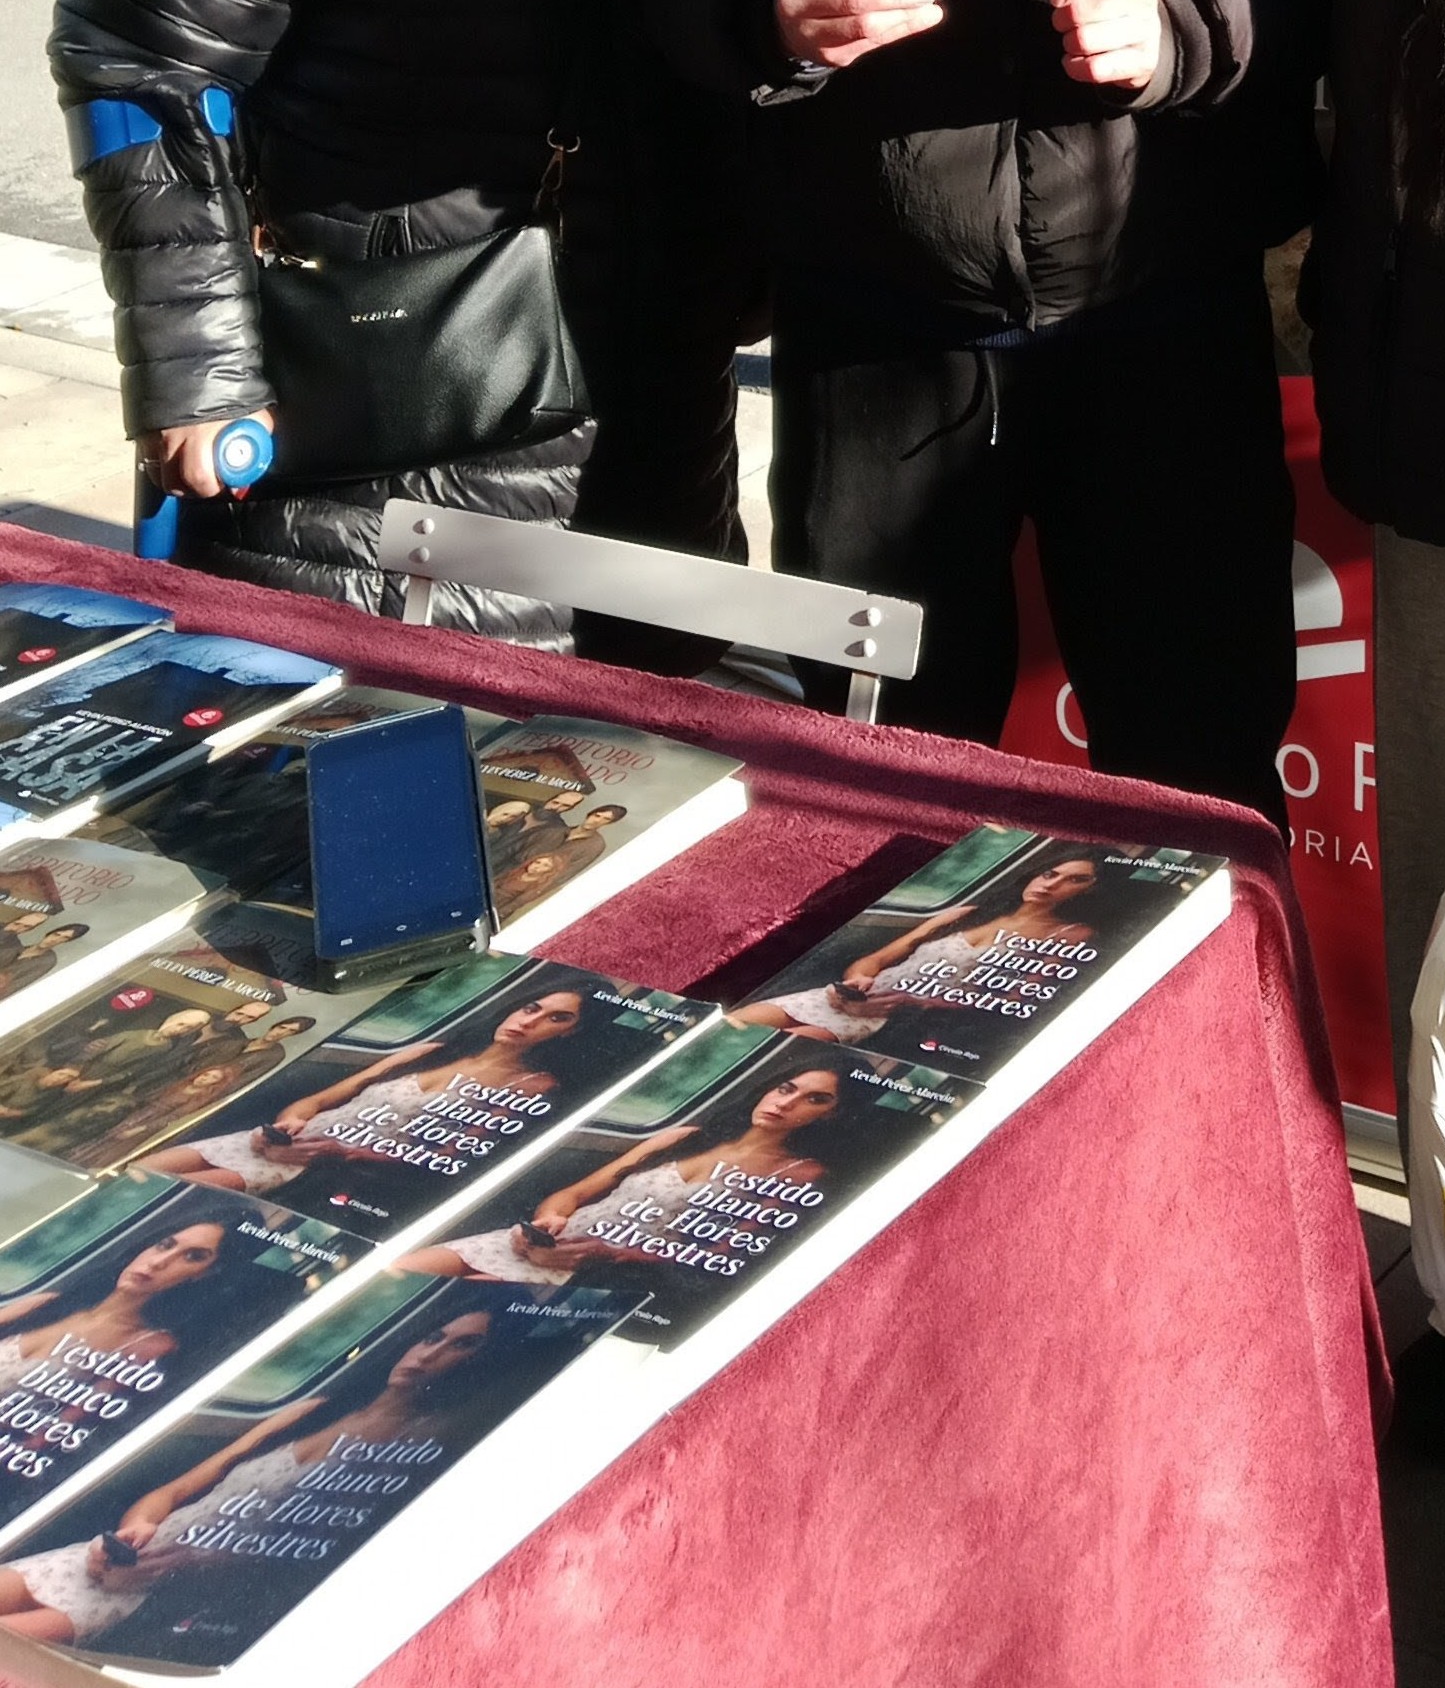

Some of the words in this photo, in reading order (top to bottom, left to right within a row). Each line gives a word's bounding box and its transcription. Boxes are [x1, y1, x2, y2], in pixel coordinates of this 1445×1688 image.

[515, 730, 656, 771] TERRITORIO
[977, 946, 1079, 984] blanco
[991, 928, 1099, 965] Vestido
[892, 973, 1037, 1021] silvestres
[918, 957, 958, 980] de
[962, 965, 1059, 1003] flores
[421, 1090, 525, 1137] blanco
[446, 1072, 553, 1118] Vestido
[323, 1119, 469, 1177] silvestres
[357, 1101, 400, 1127] de
[400, 1111, 497, 1158] flores
[687, 1182, 799, 1231] blanco
[707, 1160, 825, 1209] Vestido
[587, 1216, 746, 1279] silvestres
[618, 1197, 664, 1223] de
[665, 1206, 773, 1257] flores
[50, 1333, 168, 1392] Vestido
[17, 1359, 130, 1420] blanco
[327, 1432, 443, 1467] Vestido
[297, 1461, 408, 1496] blanco
[220, 1488, 266, 1522] de
[263, 1492, 371, 1529] flores
[175, 1519, 338, 1561] silvestres
